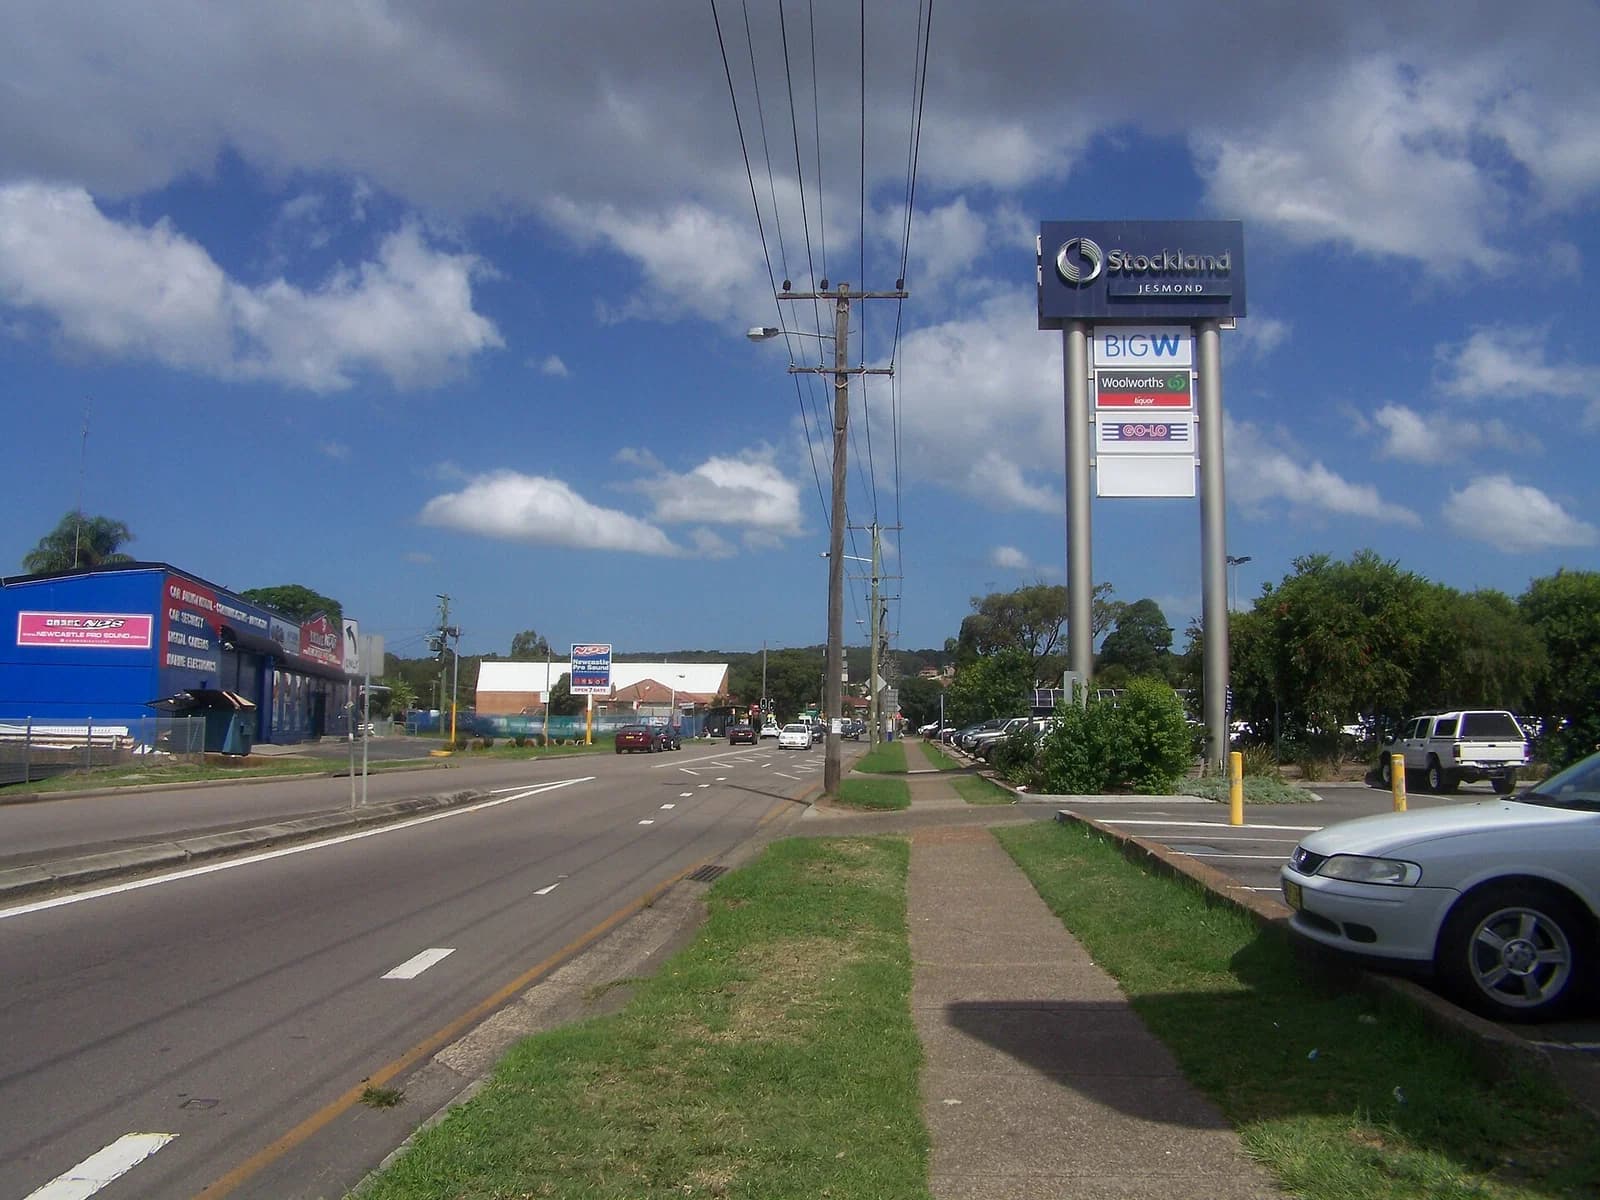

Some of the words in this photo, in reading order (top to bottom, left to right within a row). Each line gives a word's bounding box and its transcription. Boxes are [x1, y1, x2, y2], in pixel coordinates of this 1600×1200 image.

[1108, 249, 1231, 271] Stockland
[1138, 284, 1203, 294] JESMOND
[1102, 377, 1164, 388] Woolworths
[1134, 396, 1155, 406] liquor
[1122, 424, 1168, 437] GO-LO
[169, 585, 181, 600] CAR
[168, 608, 180, 621] CAR
